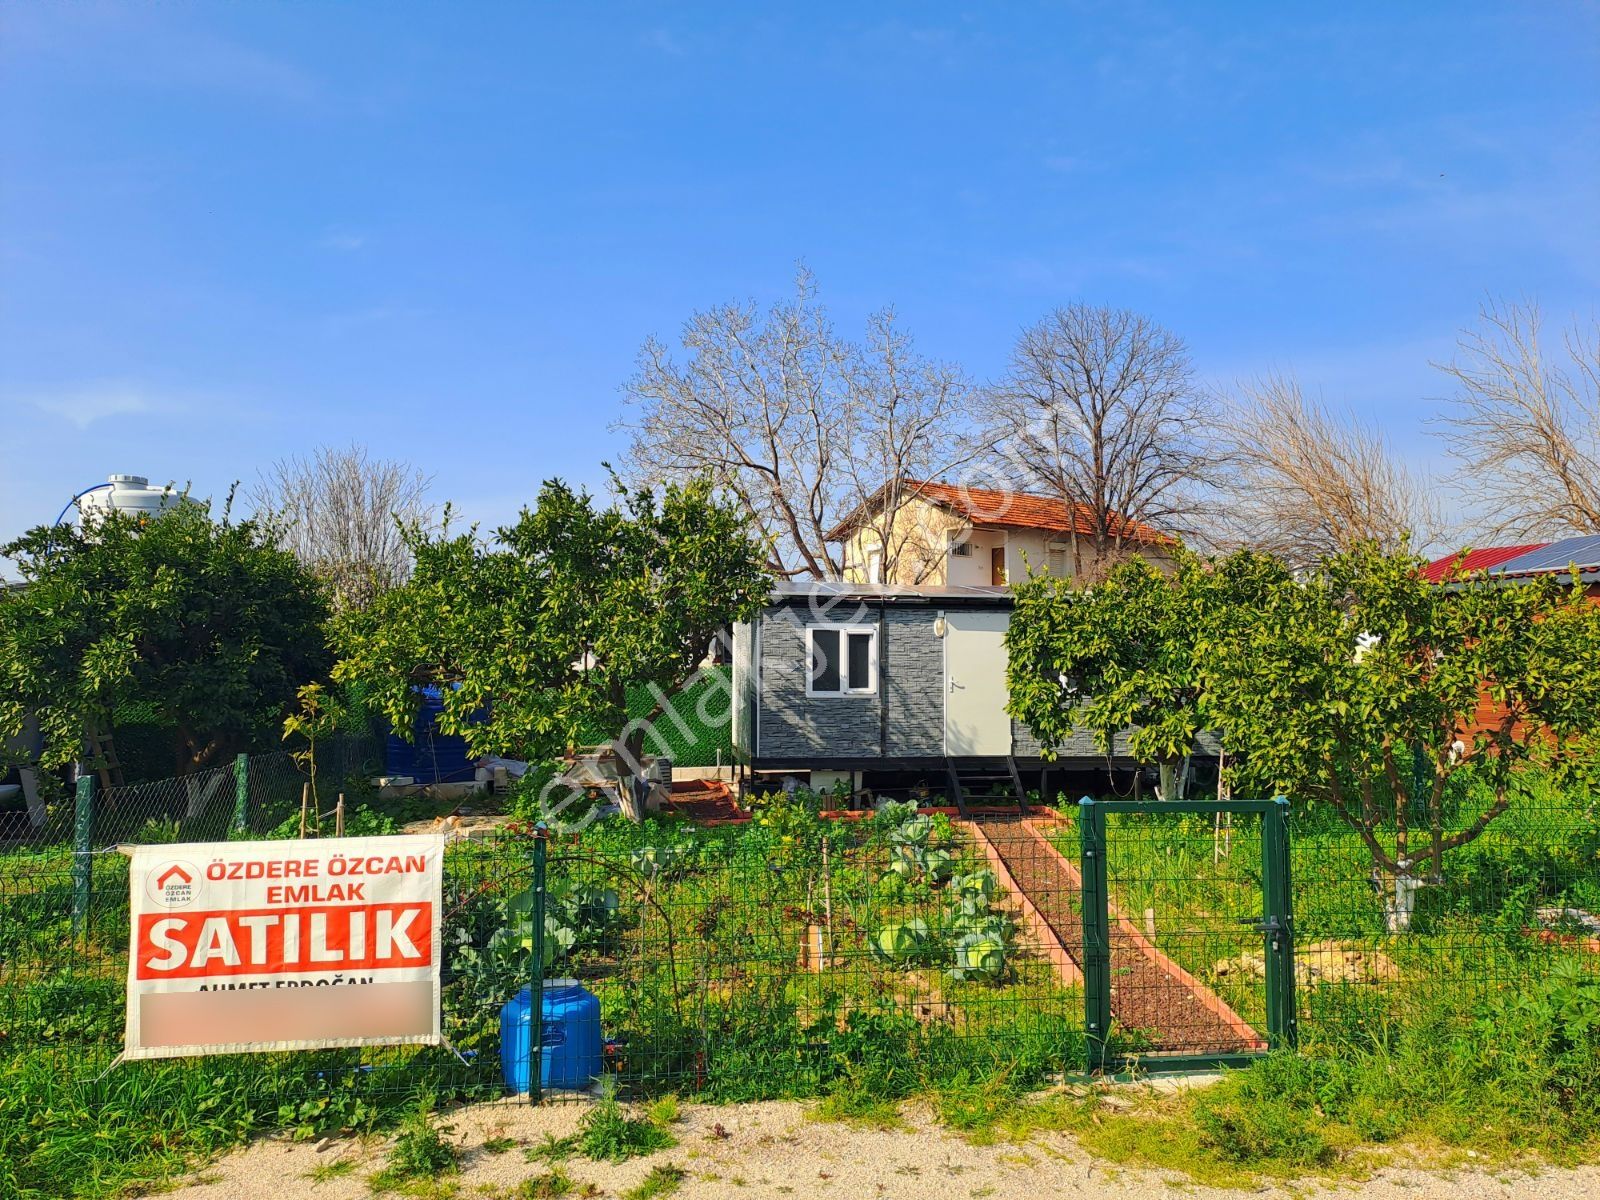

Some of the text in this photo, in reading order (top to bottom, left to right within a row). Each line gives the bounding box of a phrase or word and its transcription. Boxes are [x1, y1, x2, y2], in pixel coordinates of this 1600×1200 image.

[206, 854, 426, 881] ÖZDERE ÖZCAN
[266, 882, 366, 905] EMLAK
[145, 908, 422, 971] SATILIK
